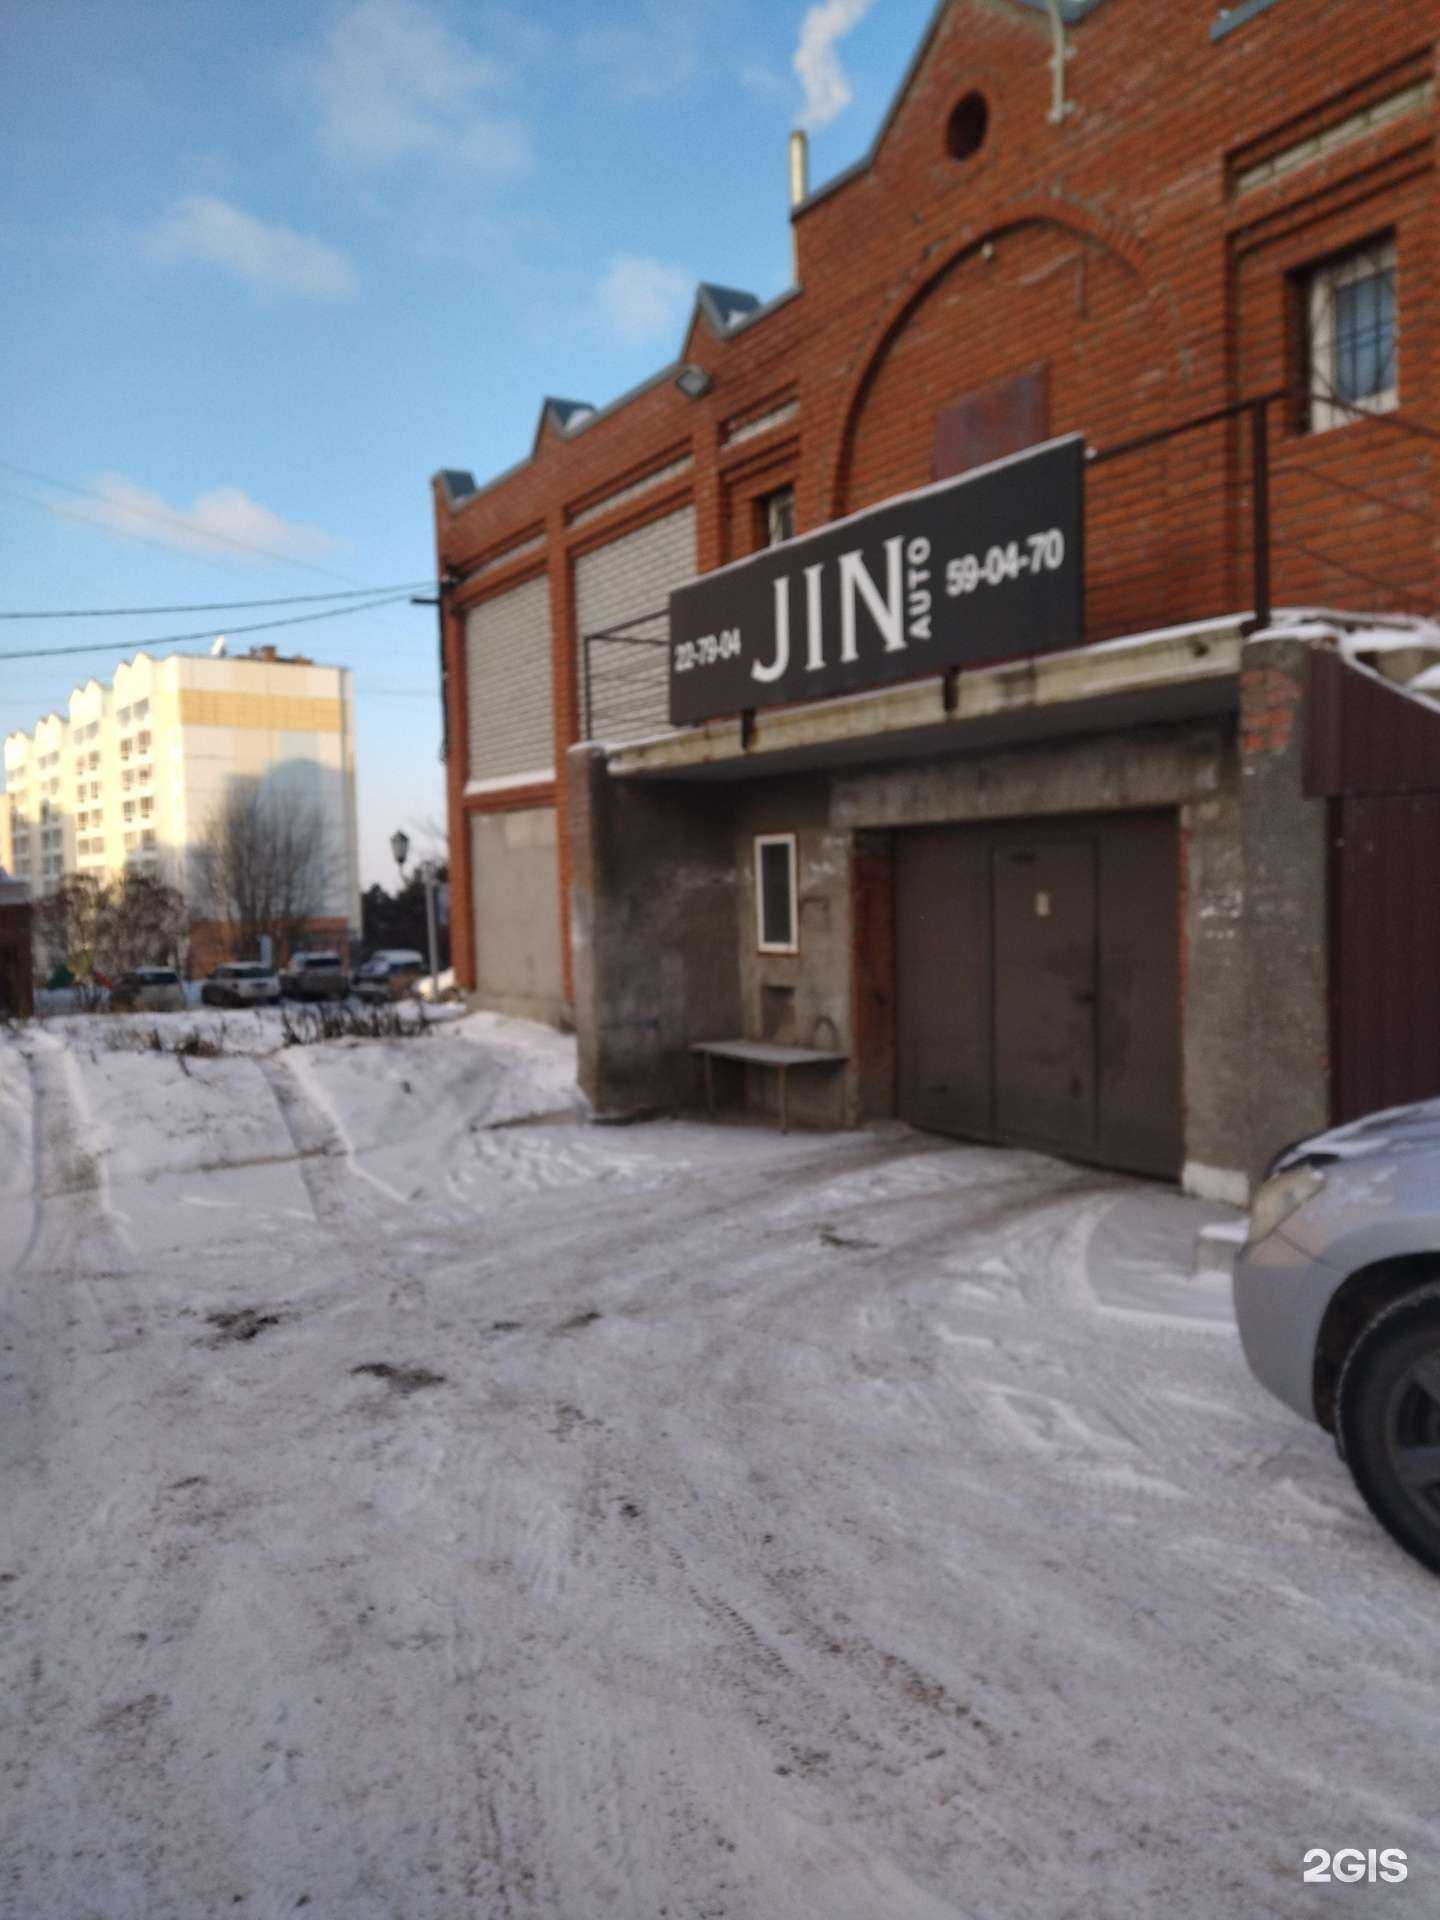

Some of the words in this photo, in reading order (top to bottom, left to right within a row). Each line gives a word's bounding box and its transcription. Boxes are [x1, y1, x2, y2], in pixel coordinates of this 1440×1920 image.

[908, 536, 932, 640] AUTO
[945, 528, 1065, 597] 59-04-70
[674, 627, 742, 672] 22-79-04
[751, 535, 908, 683] JIN
